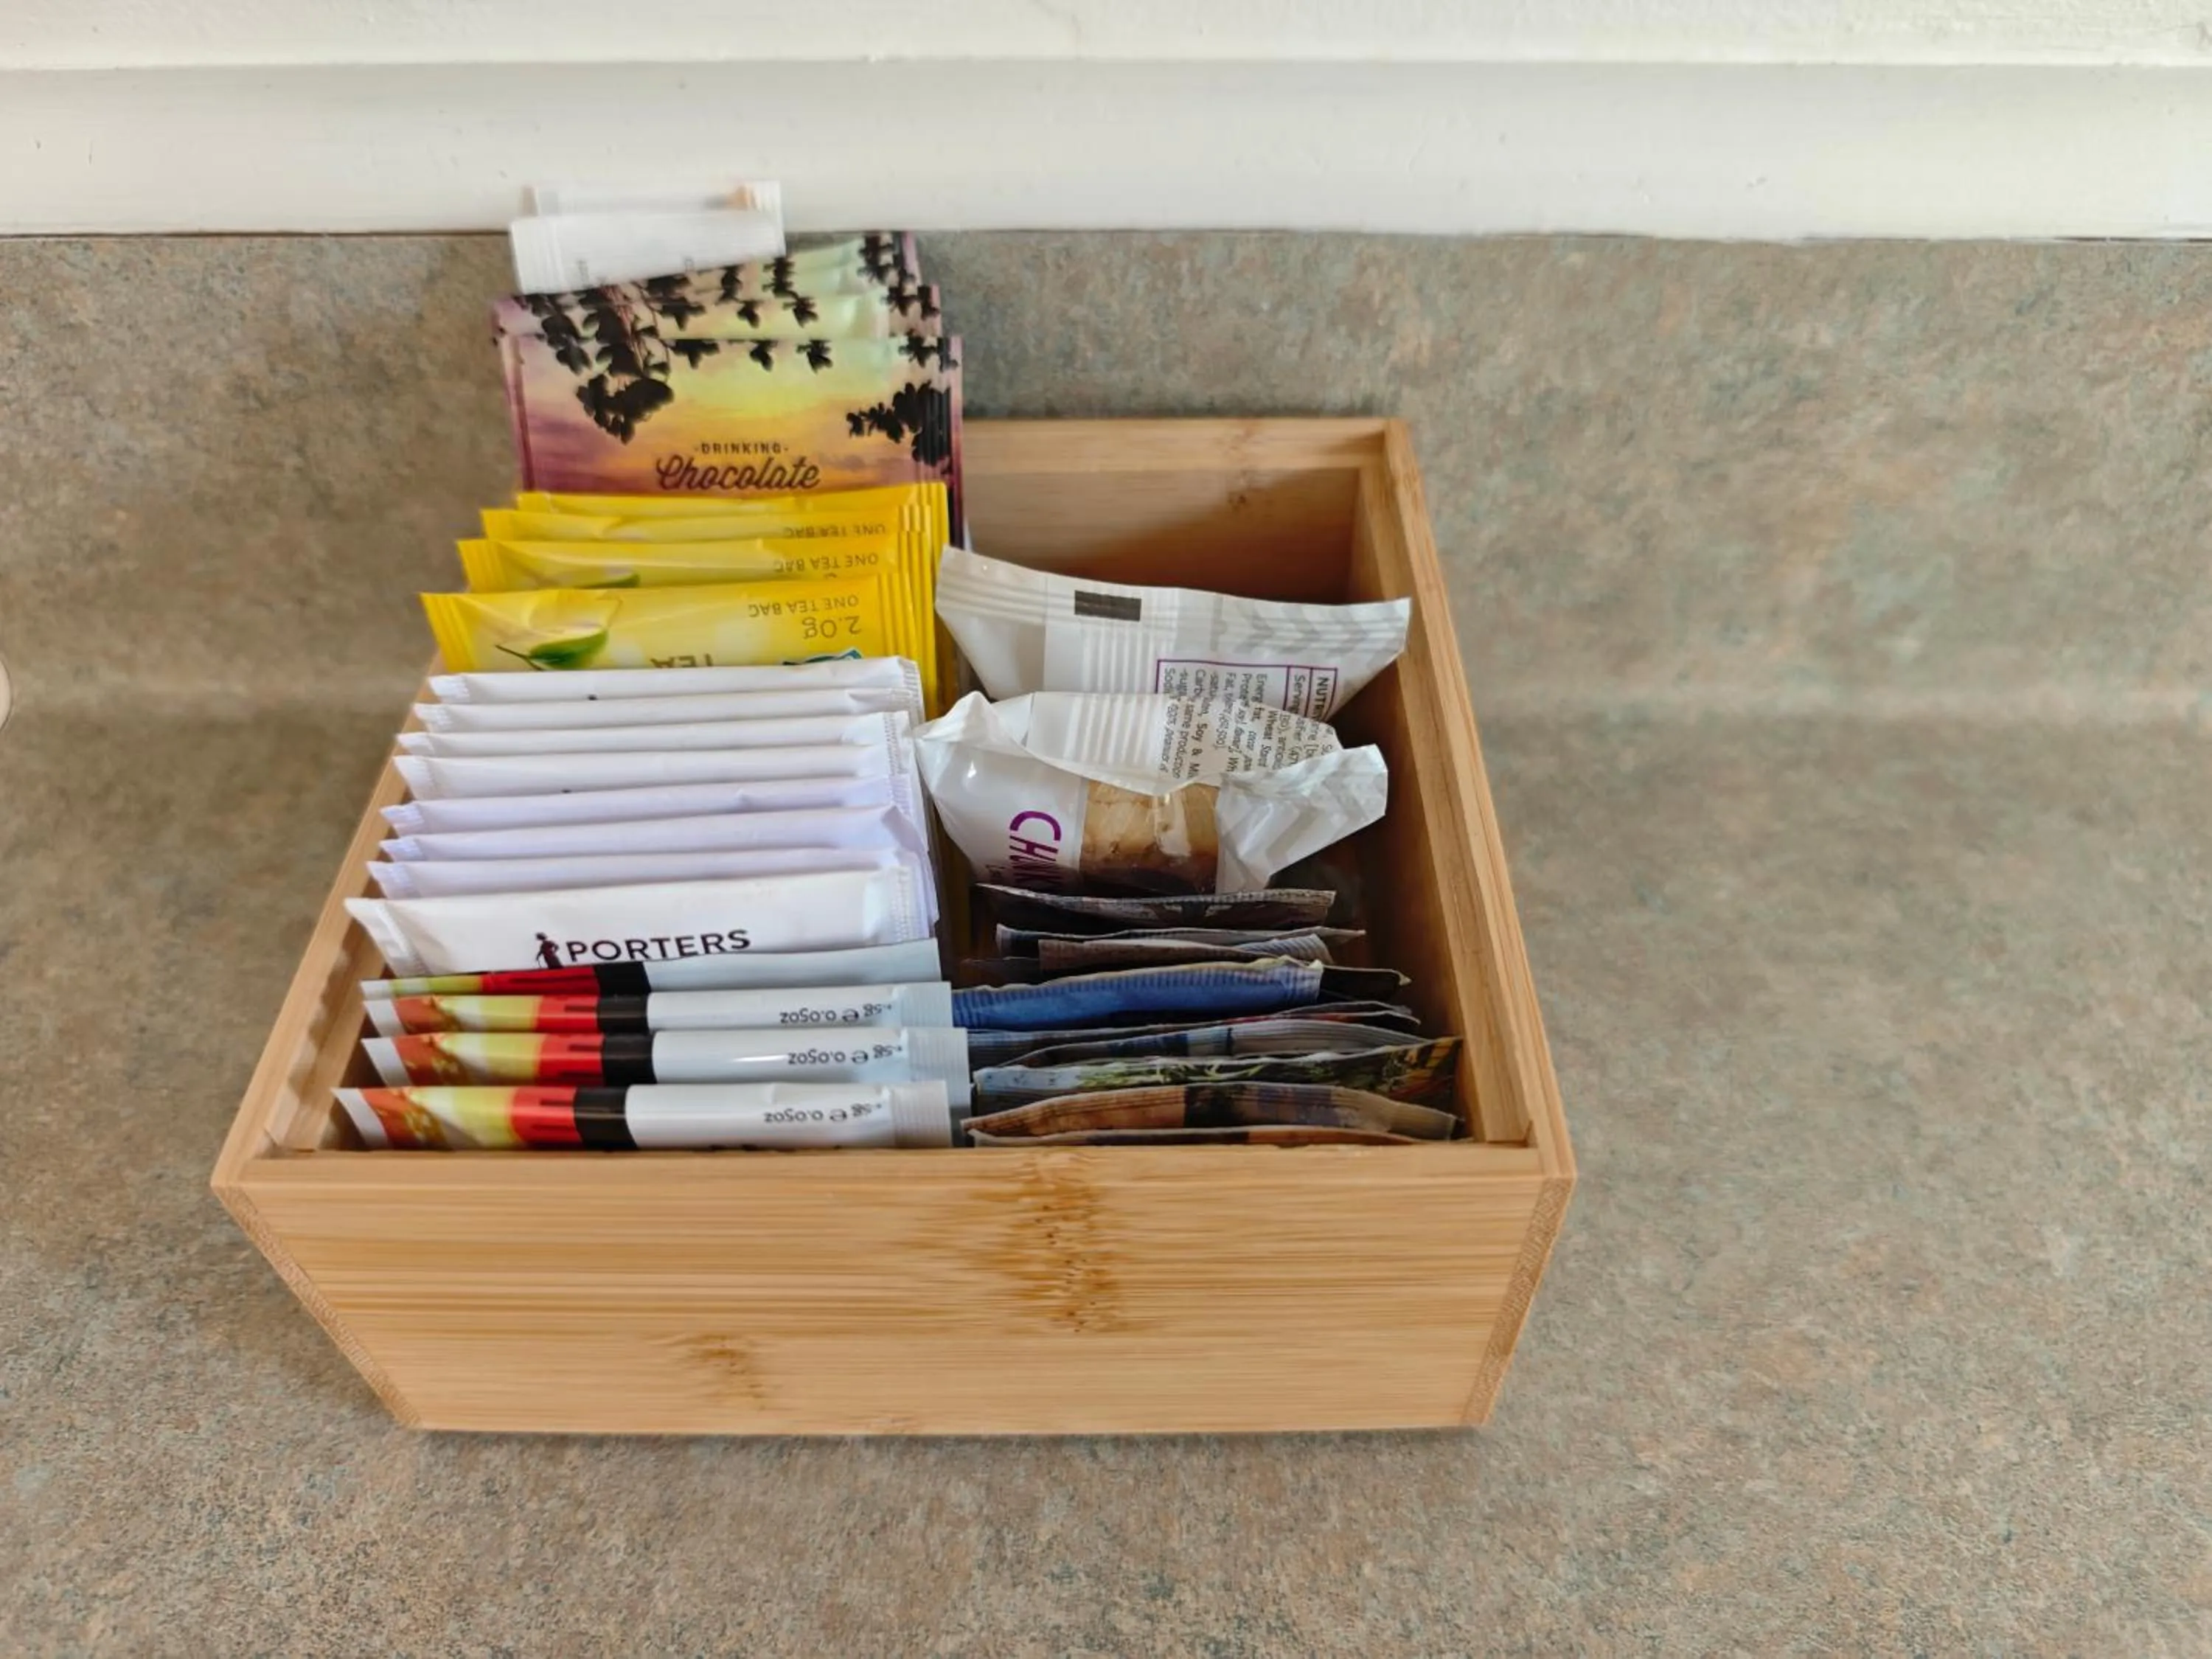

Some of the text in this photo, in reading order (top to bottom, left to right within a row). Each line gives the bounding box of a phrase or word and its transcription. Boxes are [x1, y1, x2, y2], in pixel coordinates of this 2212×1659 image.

[655, 453, 821, 490] Chocolate
[810, 555, 841, 571] TEA
[845, 552, 879, 568] ONE
[748, 594, 860, 618] ONE TEA BAG
[801, 615, 863, 641] 2.0g
[1191, 723, 1208, 742] Soy
[566, 928, 751, 962] PORTERS
